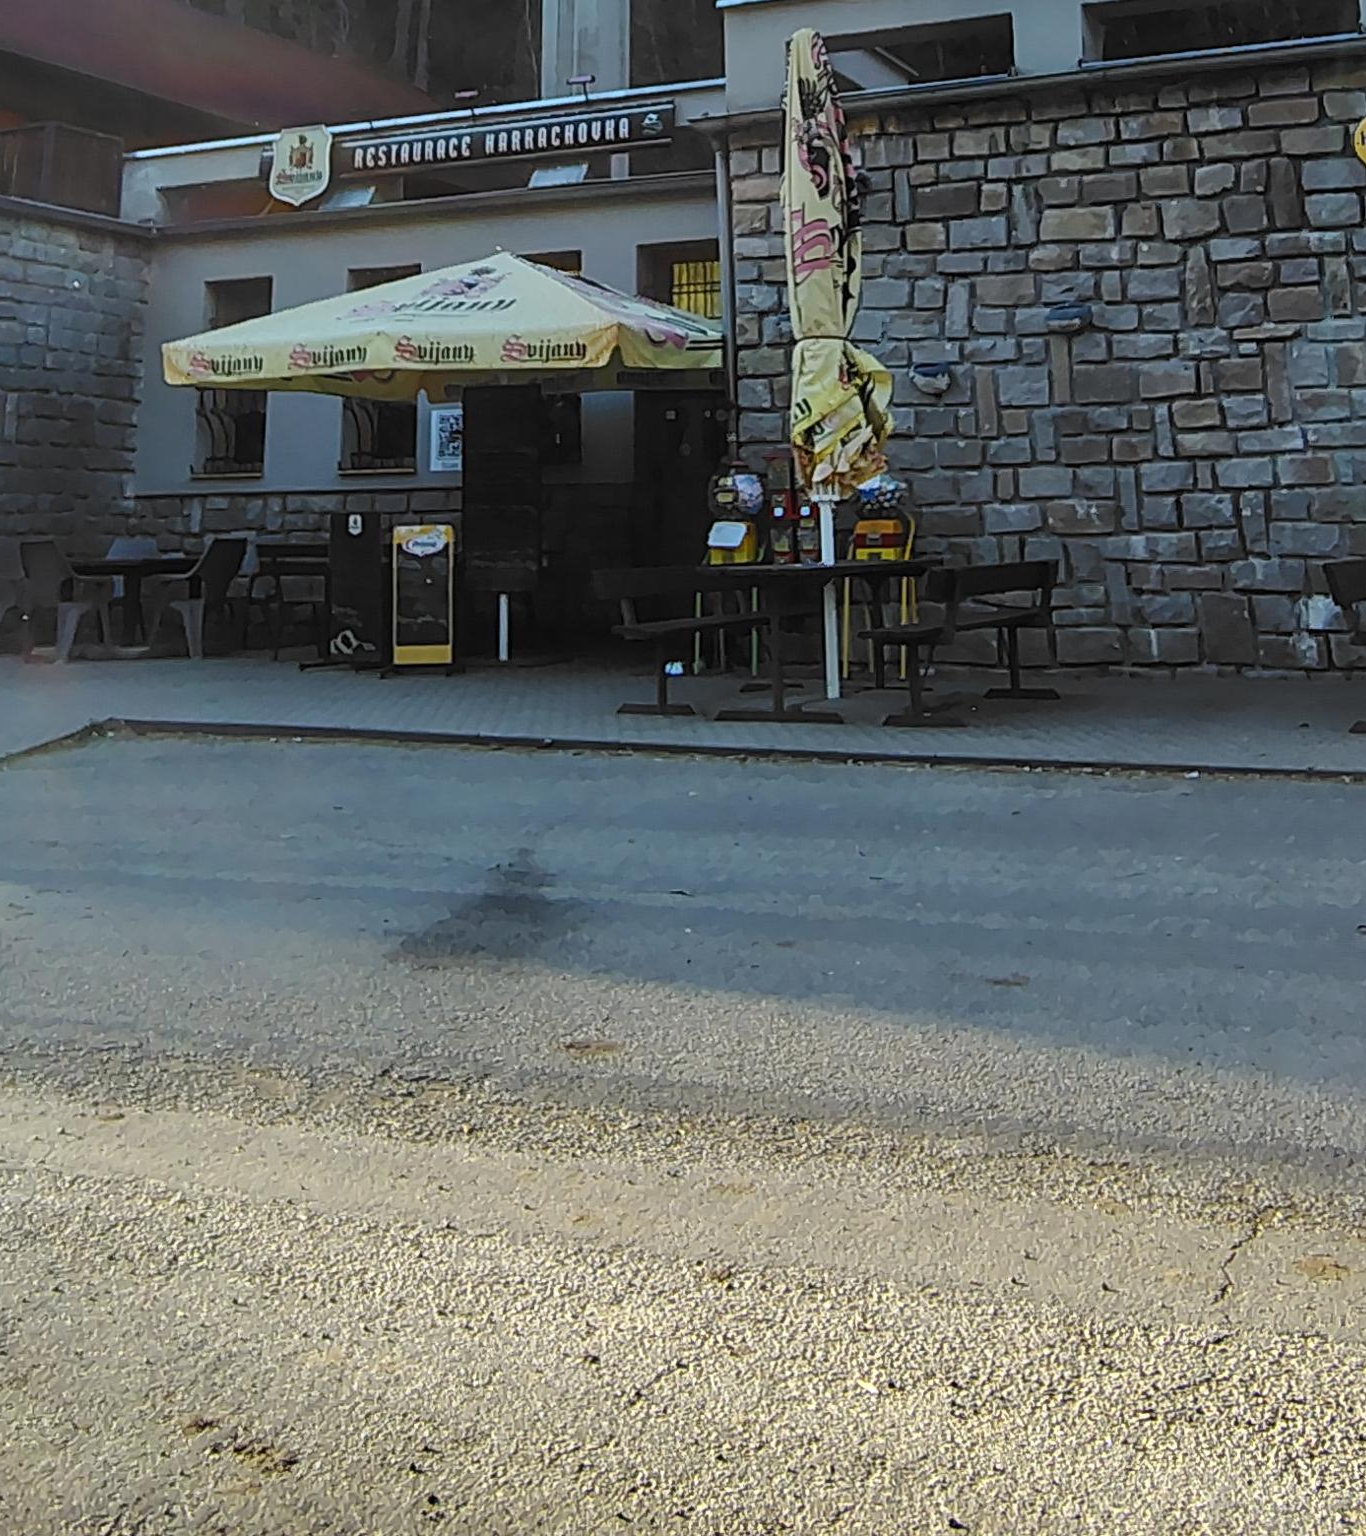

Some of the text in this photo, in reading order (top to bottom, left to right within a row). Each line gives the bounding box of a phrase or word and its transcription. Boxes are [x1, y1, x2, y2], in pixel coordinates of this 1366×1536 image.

[354, 117, 630, 169] RESTAURACE HARRACHOVKA
[187, 334, 587, 378] Svijany Svijany Svijany Svijany
